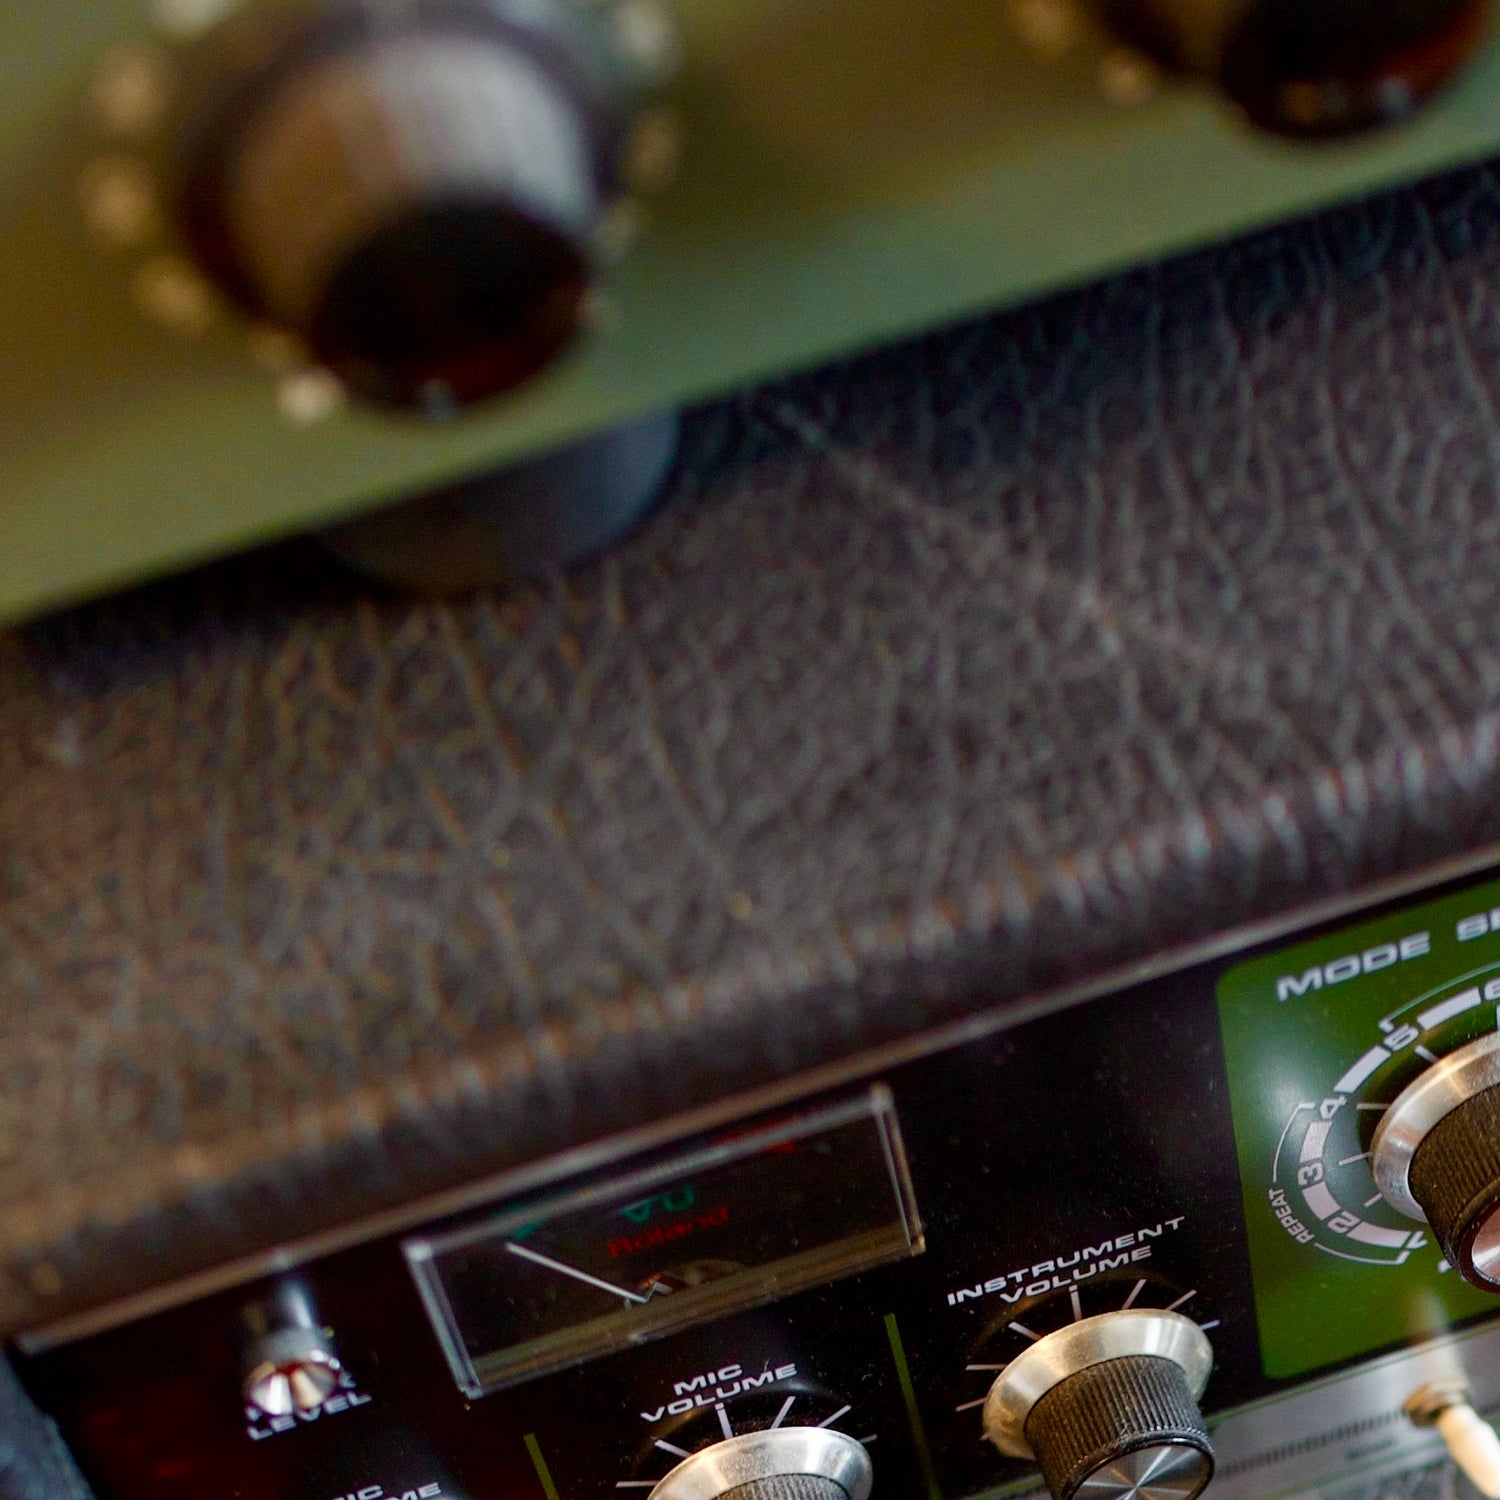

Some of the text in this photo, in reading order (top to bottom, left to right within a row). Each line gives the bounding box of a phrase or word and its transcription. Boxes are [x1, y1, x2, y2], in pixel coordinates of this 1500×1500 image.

[1275, 932, 1431, 1001] MODE
[1384, 1024, 1419, 1051] 5
[1320, 1095, 1347, 1120] 4
[1298, 1162, 1324, 1186] 3
[1268, 1188, 1316, 1244] REPEAT
[1328, 1211, 1361, 1233] 2
[947, 1216, 1185, 1306] INSTRUMENT
[999, 1244, 1152, 1303] VOLUME
[640, 1363, 798, 1423] VOLUME
[674, 1363, 743, 1396] MIC
